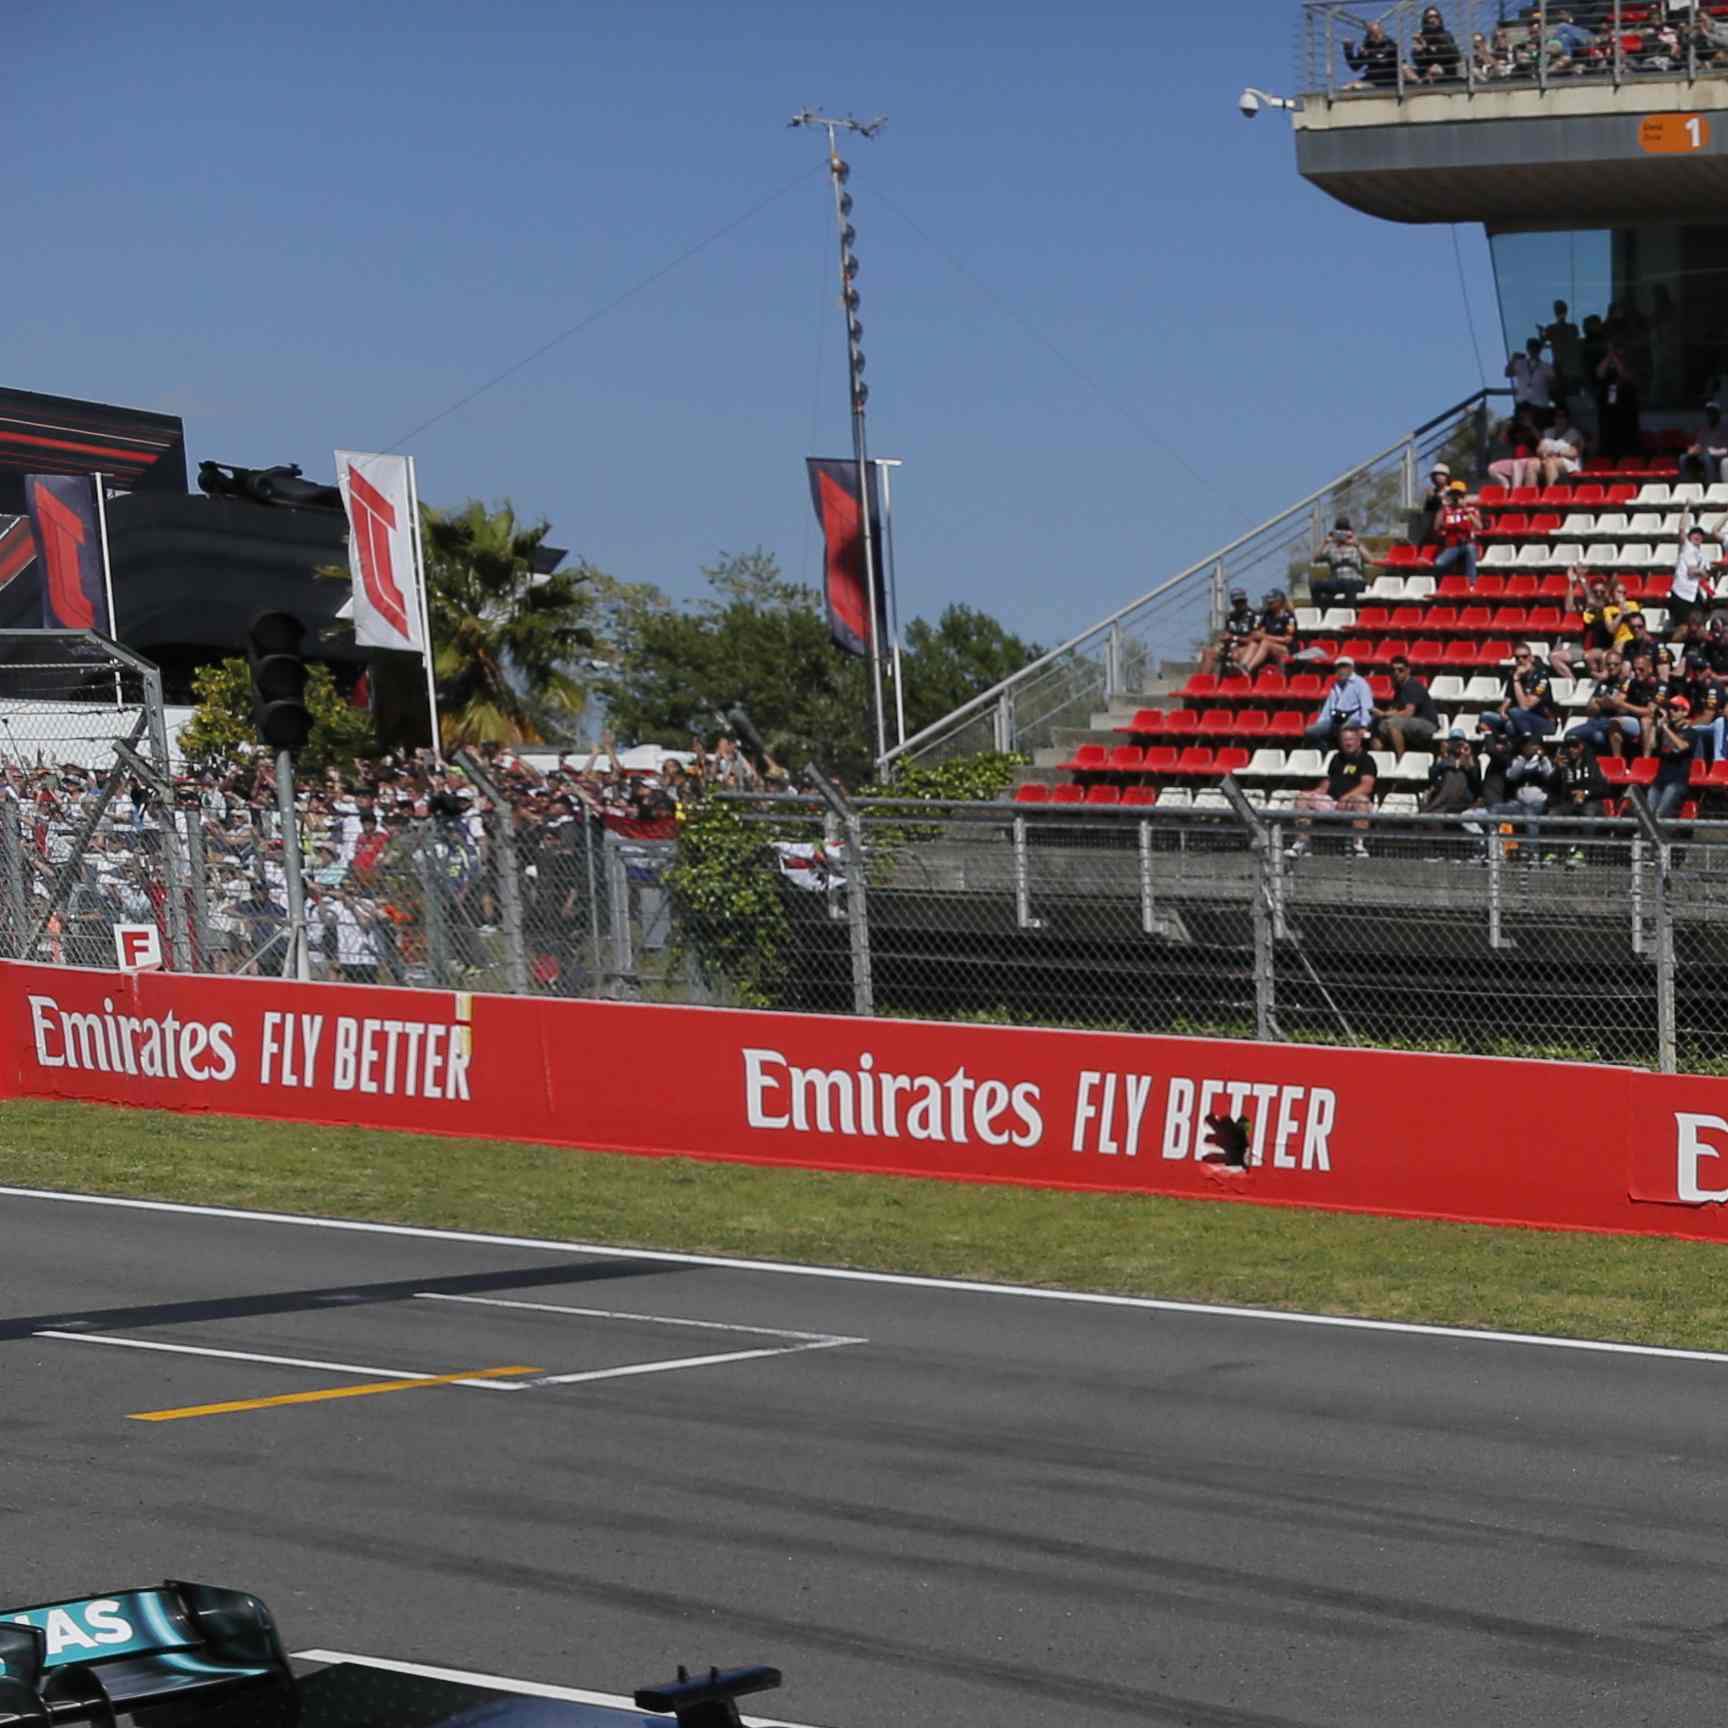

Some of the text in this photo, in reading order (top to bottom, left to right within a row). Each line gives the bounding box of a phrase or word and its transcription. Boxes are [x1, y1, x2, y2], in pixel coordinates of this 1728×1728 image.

[1685, 118, 1700, 148] 1
[122, 931, 150, 968] F
[28, 995, 471, 1101] Emirates FLY BETTER
[741, 1047, 1044, 1148] Emirates
[1071, 1070, 1152, 1157] FLY
